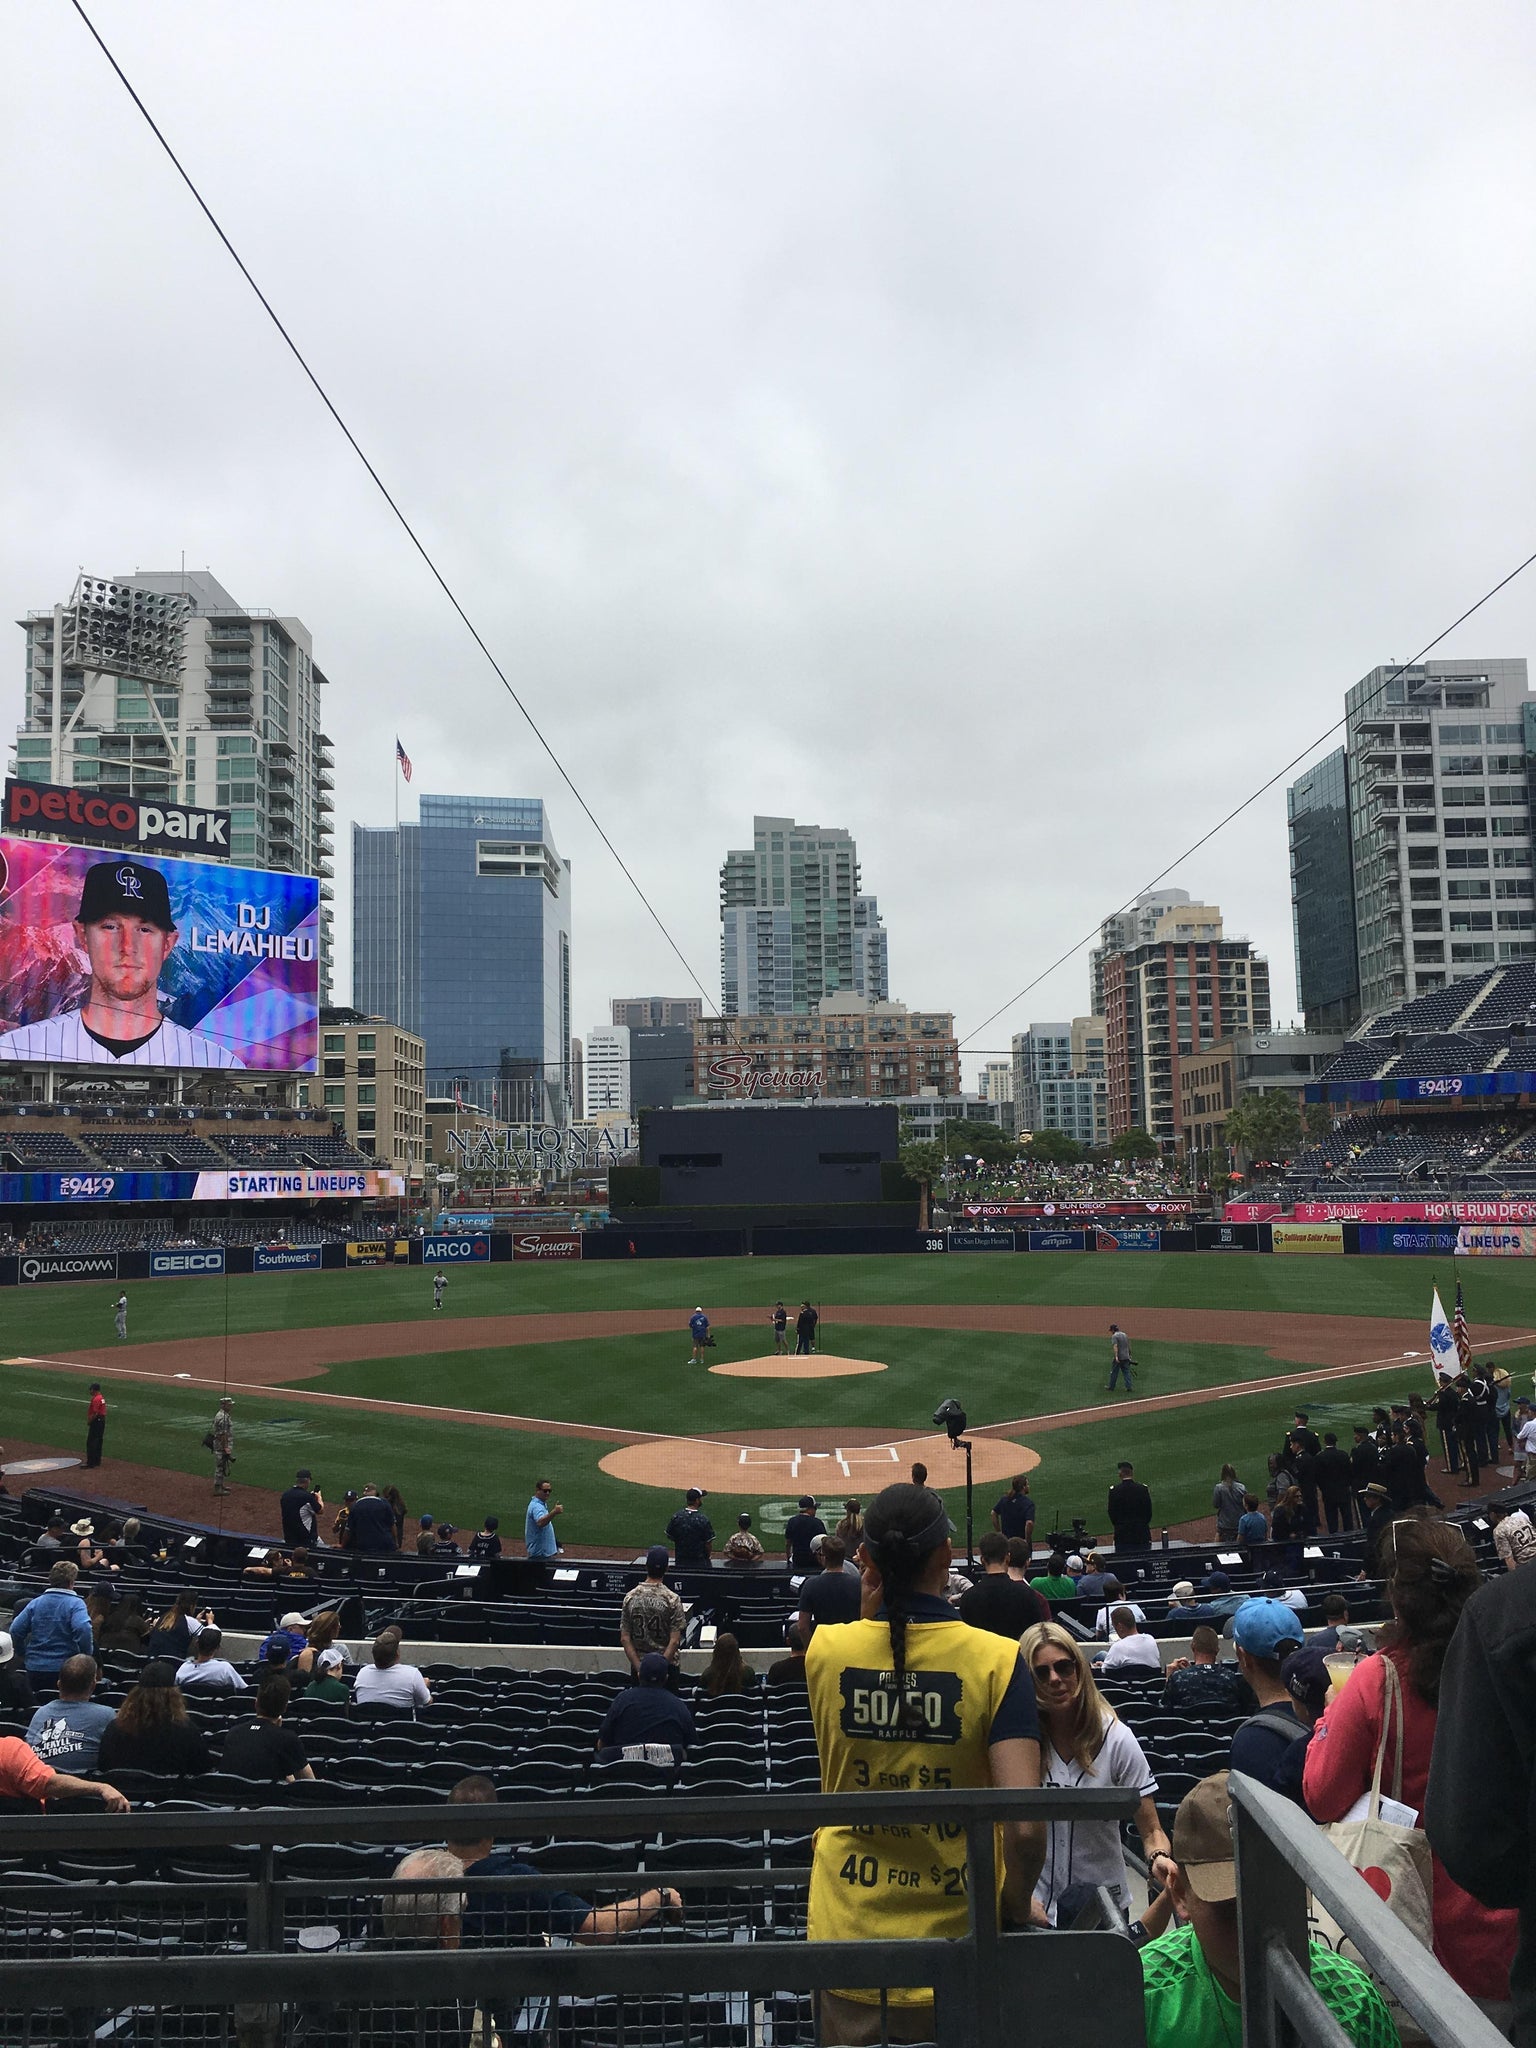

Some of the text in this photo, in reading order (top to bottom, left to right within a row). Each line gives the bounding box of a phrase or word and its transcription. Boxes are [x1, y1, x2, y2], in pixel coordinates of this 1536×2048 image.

[238, 904, 271, 930] DJ
[708, 1055, 827, 1097] Sycuan
[445, 1127, 639, 1153] NATIONAL
[461, 1151, 623, 1171] UNIVERSITY
[60, 1178, 69, 1195] FM
[229, 1177, 366, 1192] STARTING LINEUPS
[982, 1206, 1008, 1214] ROXY
[1161, 1204, 1187, 1212] ROXY
[1425, 1205, 1465, 1216] HOME
[1468, 1205, 1497, 1216] RUN
[1041, 1237, 1072, 1248] ampm
[1123, 1232, 1141, 1240] SHIN
[1284, 1233, 1306, 1242] Sullivan
[1393, 1234, 1521, 1248] STARTING LINEUPS
[425, 1242, 471, 1257] ARCO
[519, 1236, 576, 1256] Sycuan
[926, 1239, 943, 1250] 396
[154, 1254, 222, 1271] GEICO
[258, 1253, 311, 1265] Southwest
[23, 1260, 113, 1280] QUALCOMM
[632, 1614, 662, 1640] 34
[879, 1671, 917, 1688] PAES
[854, 1688, 942, 1729] 50/50
[878, 1730, 917, 1739] RAFFLE
[42, 1738, 70, 1751] JEKYLL
[48, 1742, 83, 1757] FROSTIE
[853, 1759, 952, 1789] 3 FOR $5
[840, 1854, 879, 1888] 40
[888, 1868, 920, 1888] FOR
